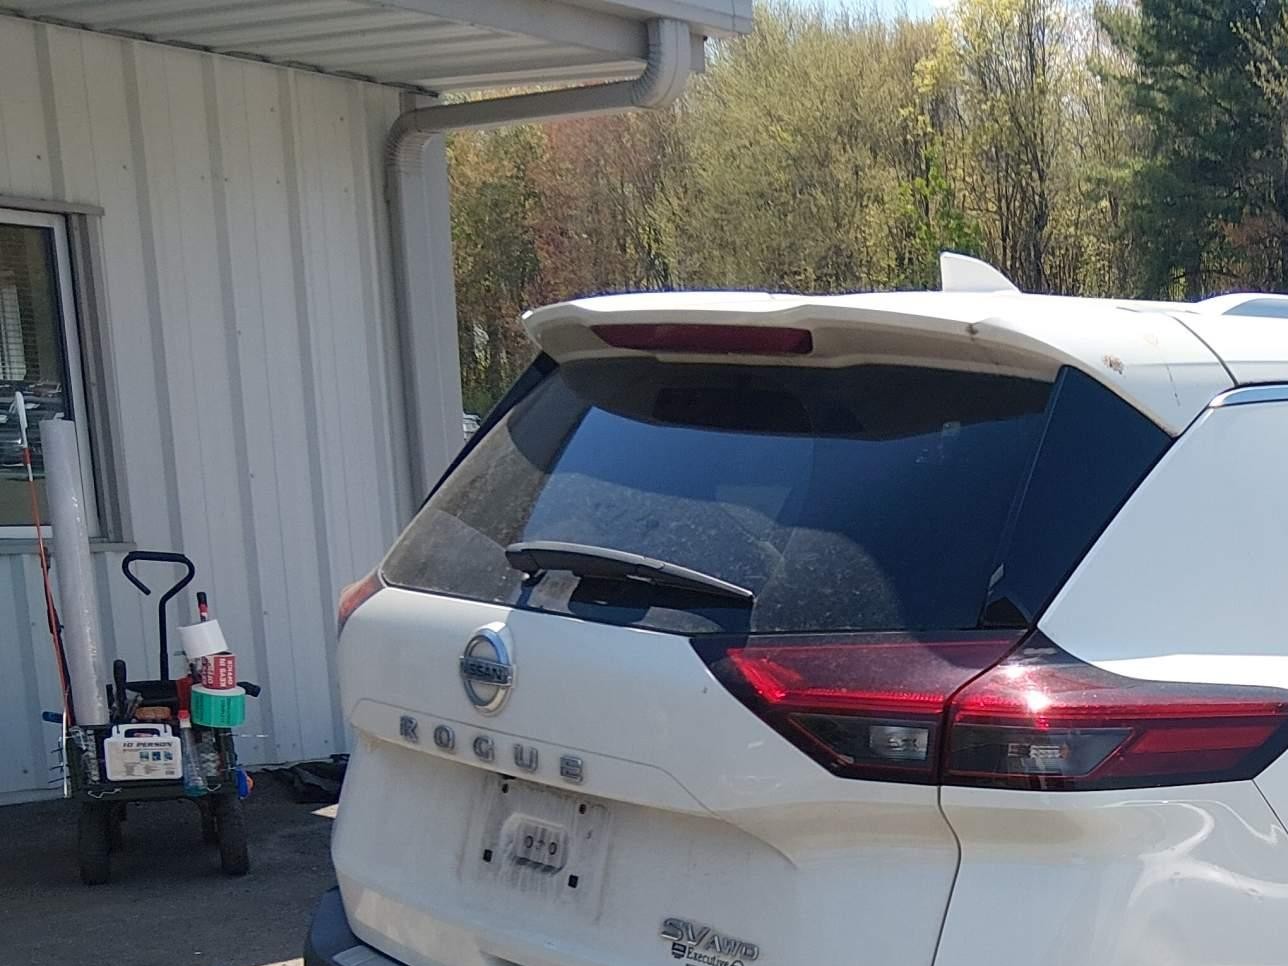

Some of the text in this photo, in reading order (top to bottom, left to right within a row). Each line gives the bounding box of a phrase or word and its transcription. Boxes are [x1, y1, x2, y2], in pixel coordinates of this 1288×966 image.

[219, 657, 227, 687] KEYS IN
[463, 661, 510, 682] NISSAN
[400, 715, 584, 784] ROGUE
[661, 918, 711, 946] SV
[704, 935, 760, 960] AWD
